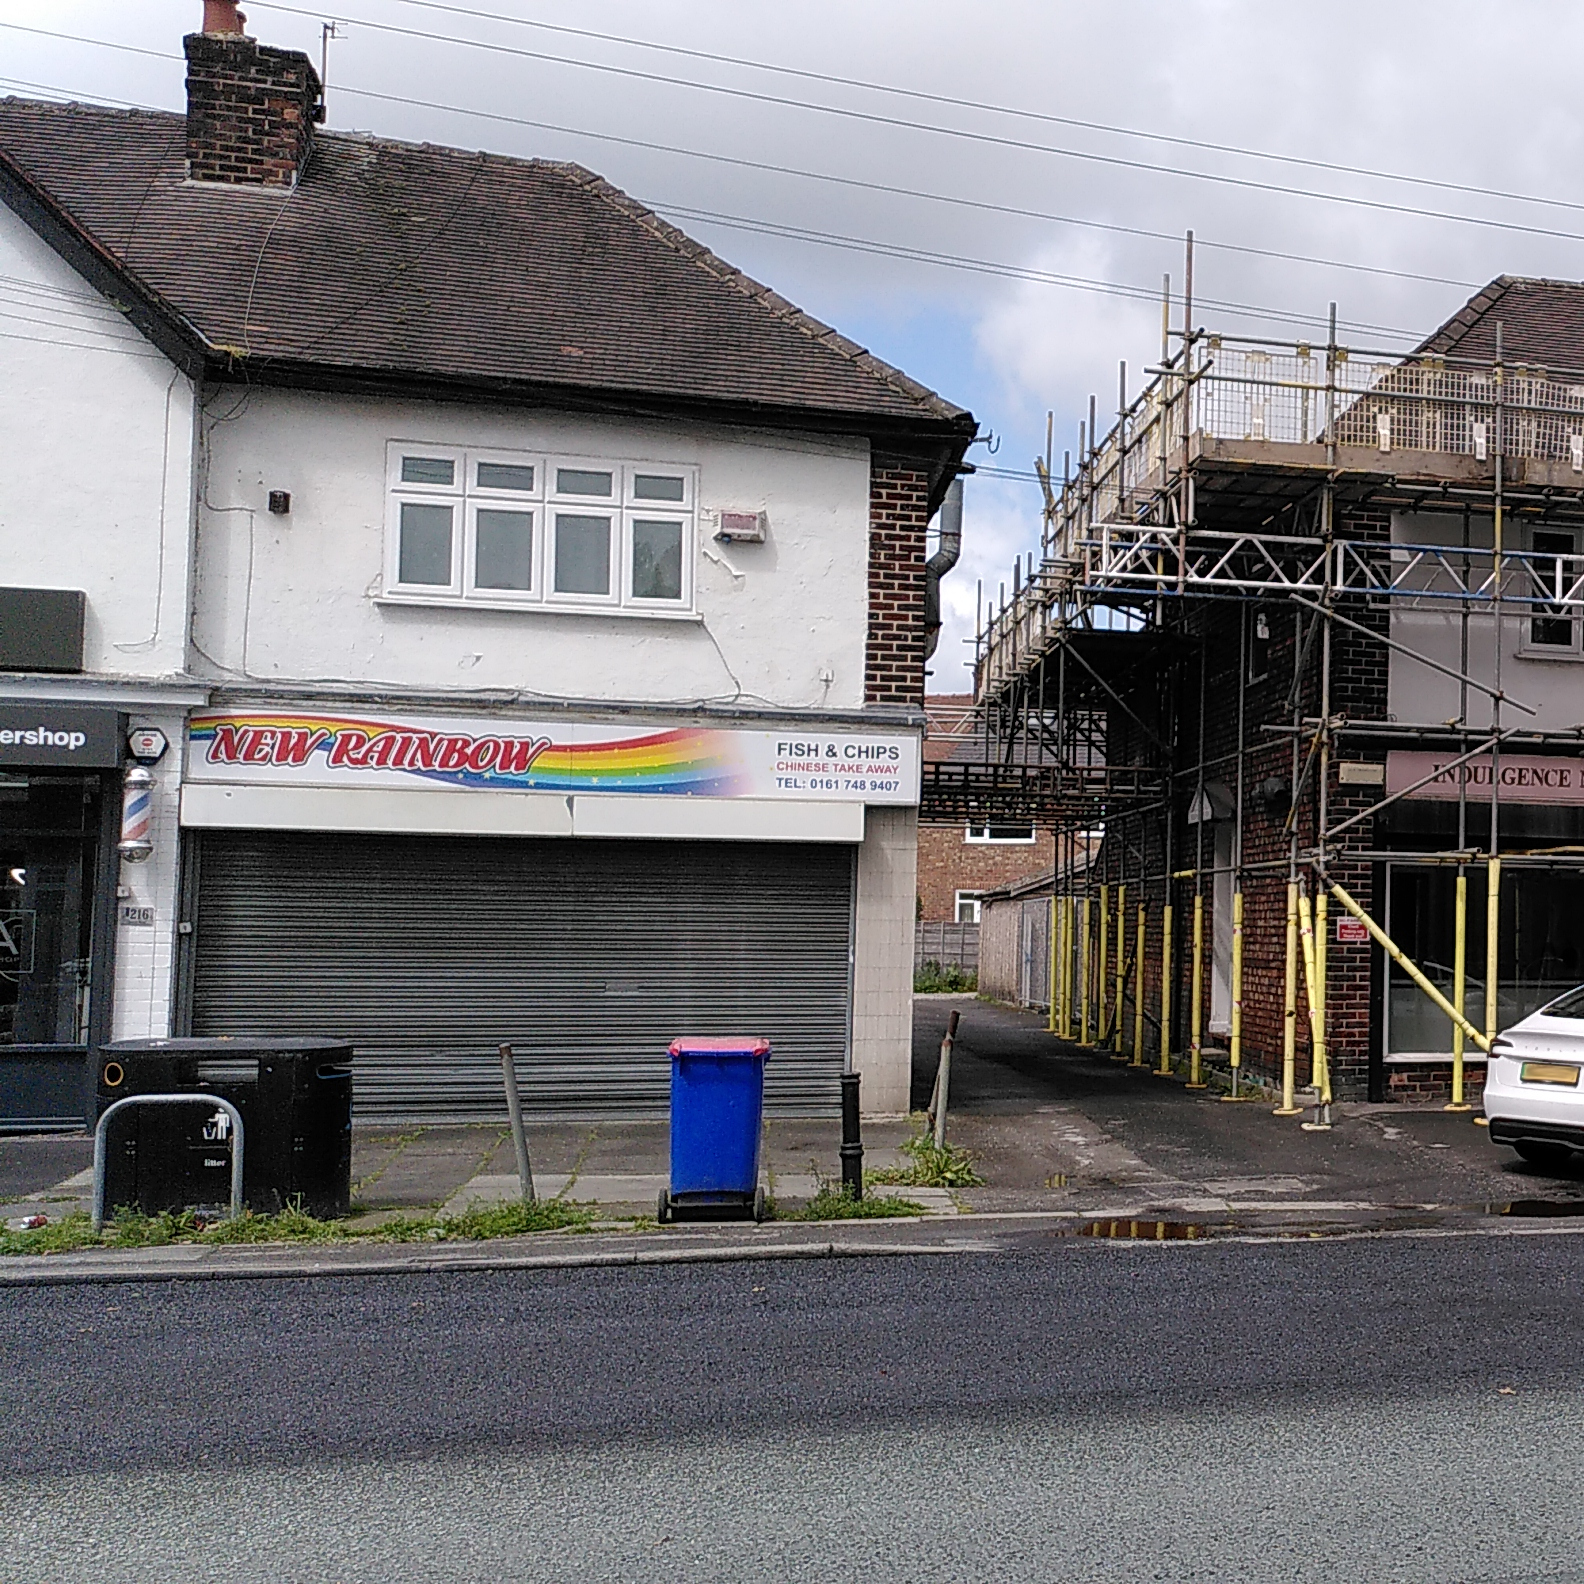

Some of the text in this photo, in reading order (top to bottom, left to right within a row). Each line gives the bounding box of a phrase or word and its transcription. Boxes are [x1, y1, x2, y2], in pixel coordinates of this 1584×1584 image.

[0, 727, 86, 749] ershop
[208, 725, 549, 772] NEW RAINBOW
[777, 742, 900, 760] FISH & CHIPS
[776, 761, 899, 775] CHINESE TAKE AWAY
[776, 777, 900, 792] TEL: 0161 748 9407
[204, 1159, 226, 1167] litter
